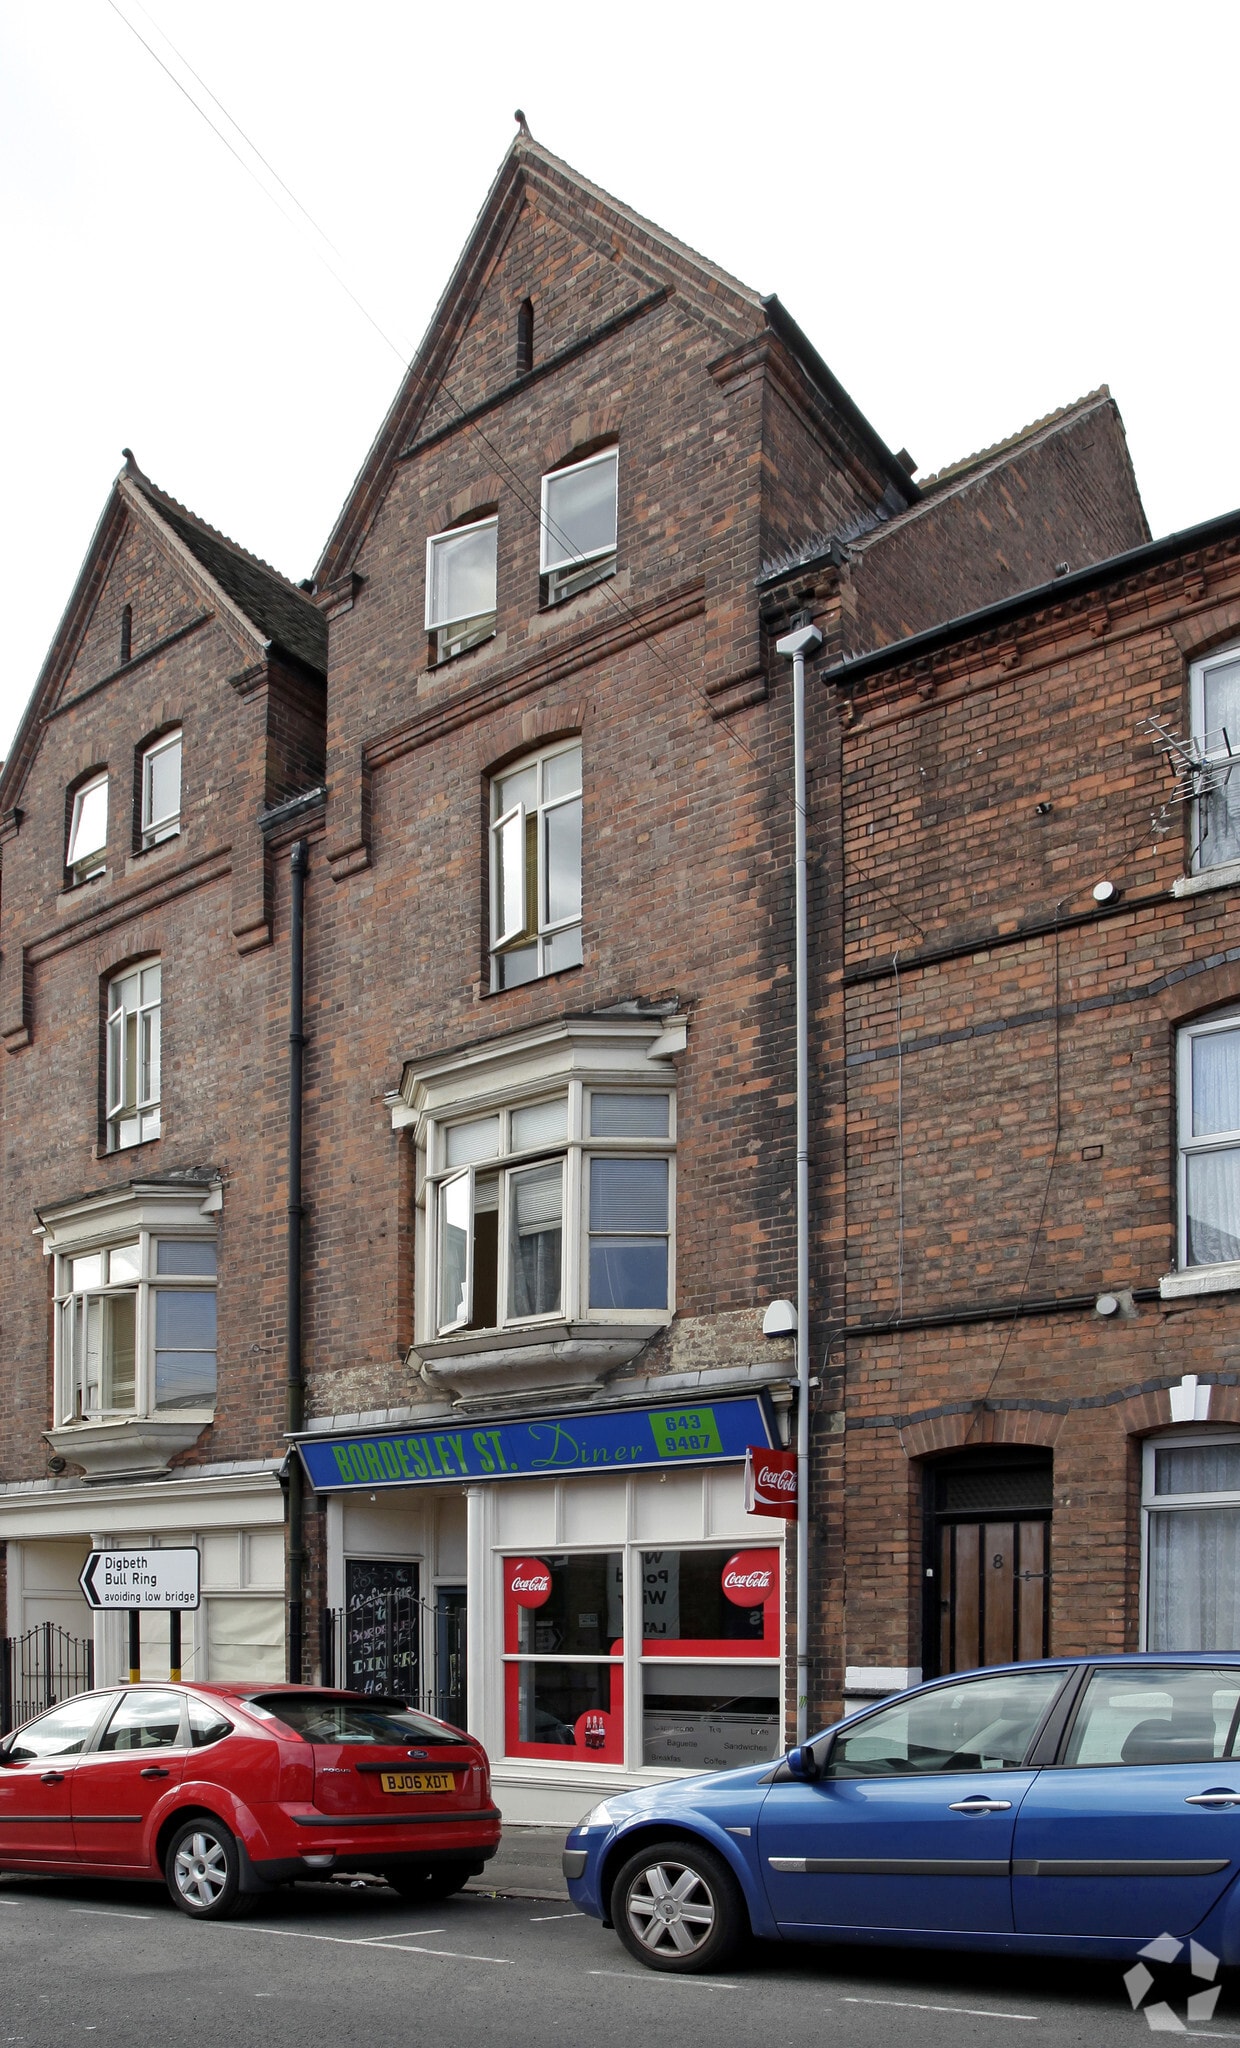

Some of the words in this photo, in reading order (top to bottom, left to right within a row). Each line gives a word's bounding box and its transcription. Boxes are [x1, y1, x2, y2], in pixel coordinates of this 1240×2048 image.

[665, 1414, 701, 1432] 643
[665, 1433, 711, 1452] 9487
[331, 1432, 469, 1482] BORDESLEY
[479, 1430, 519, 1473] ST.
[528, 1424, 643, 1468] Diner
[105, 1556, 148, 1571] Digbeth
[992, 1553, 1004, 1569] 8
[105, 1573, 127, 1585] Bull
[132, 1572, 157, 1587] Ring
[511, 1575, 550, 1593] Coca-Cola
[724, 1570, 773, 1588] Coca-Cola
[104, 1592, 141, 1603] avoiding
[145, 1591, 161, 1602] low
[165, 1590, 195, 1603] bridge
[724, 1742, 768, 1752] Sandwiches
[703, 1757, 727, 1765] Coffee
[387, 1775, 422, 1789] BJ06
[424, 1775, 448, 1788] XDT
